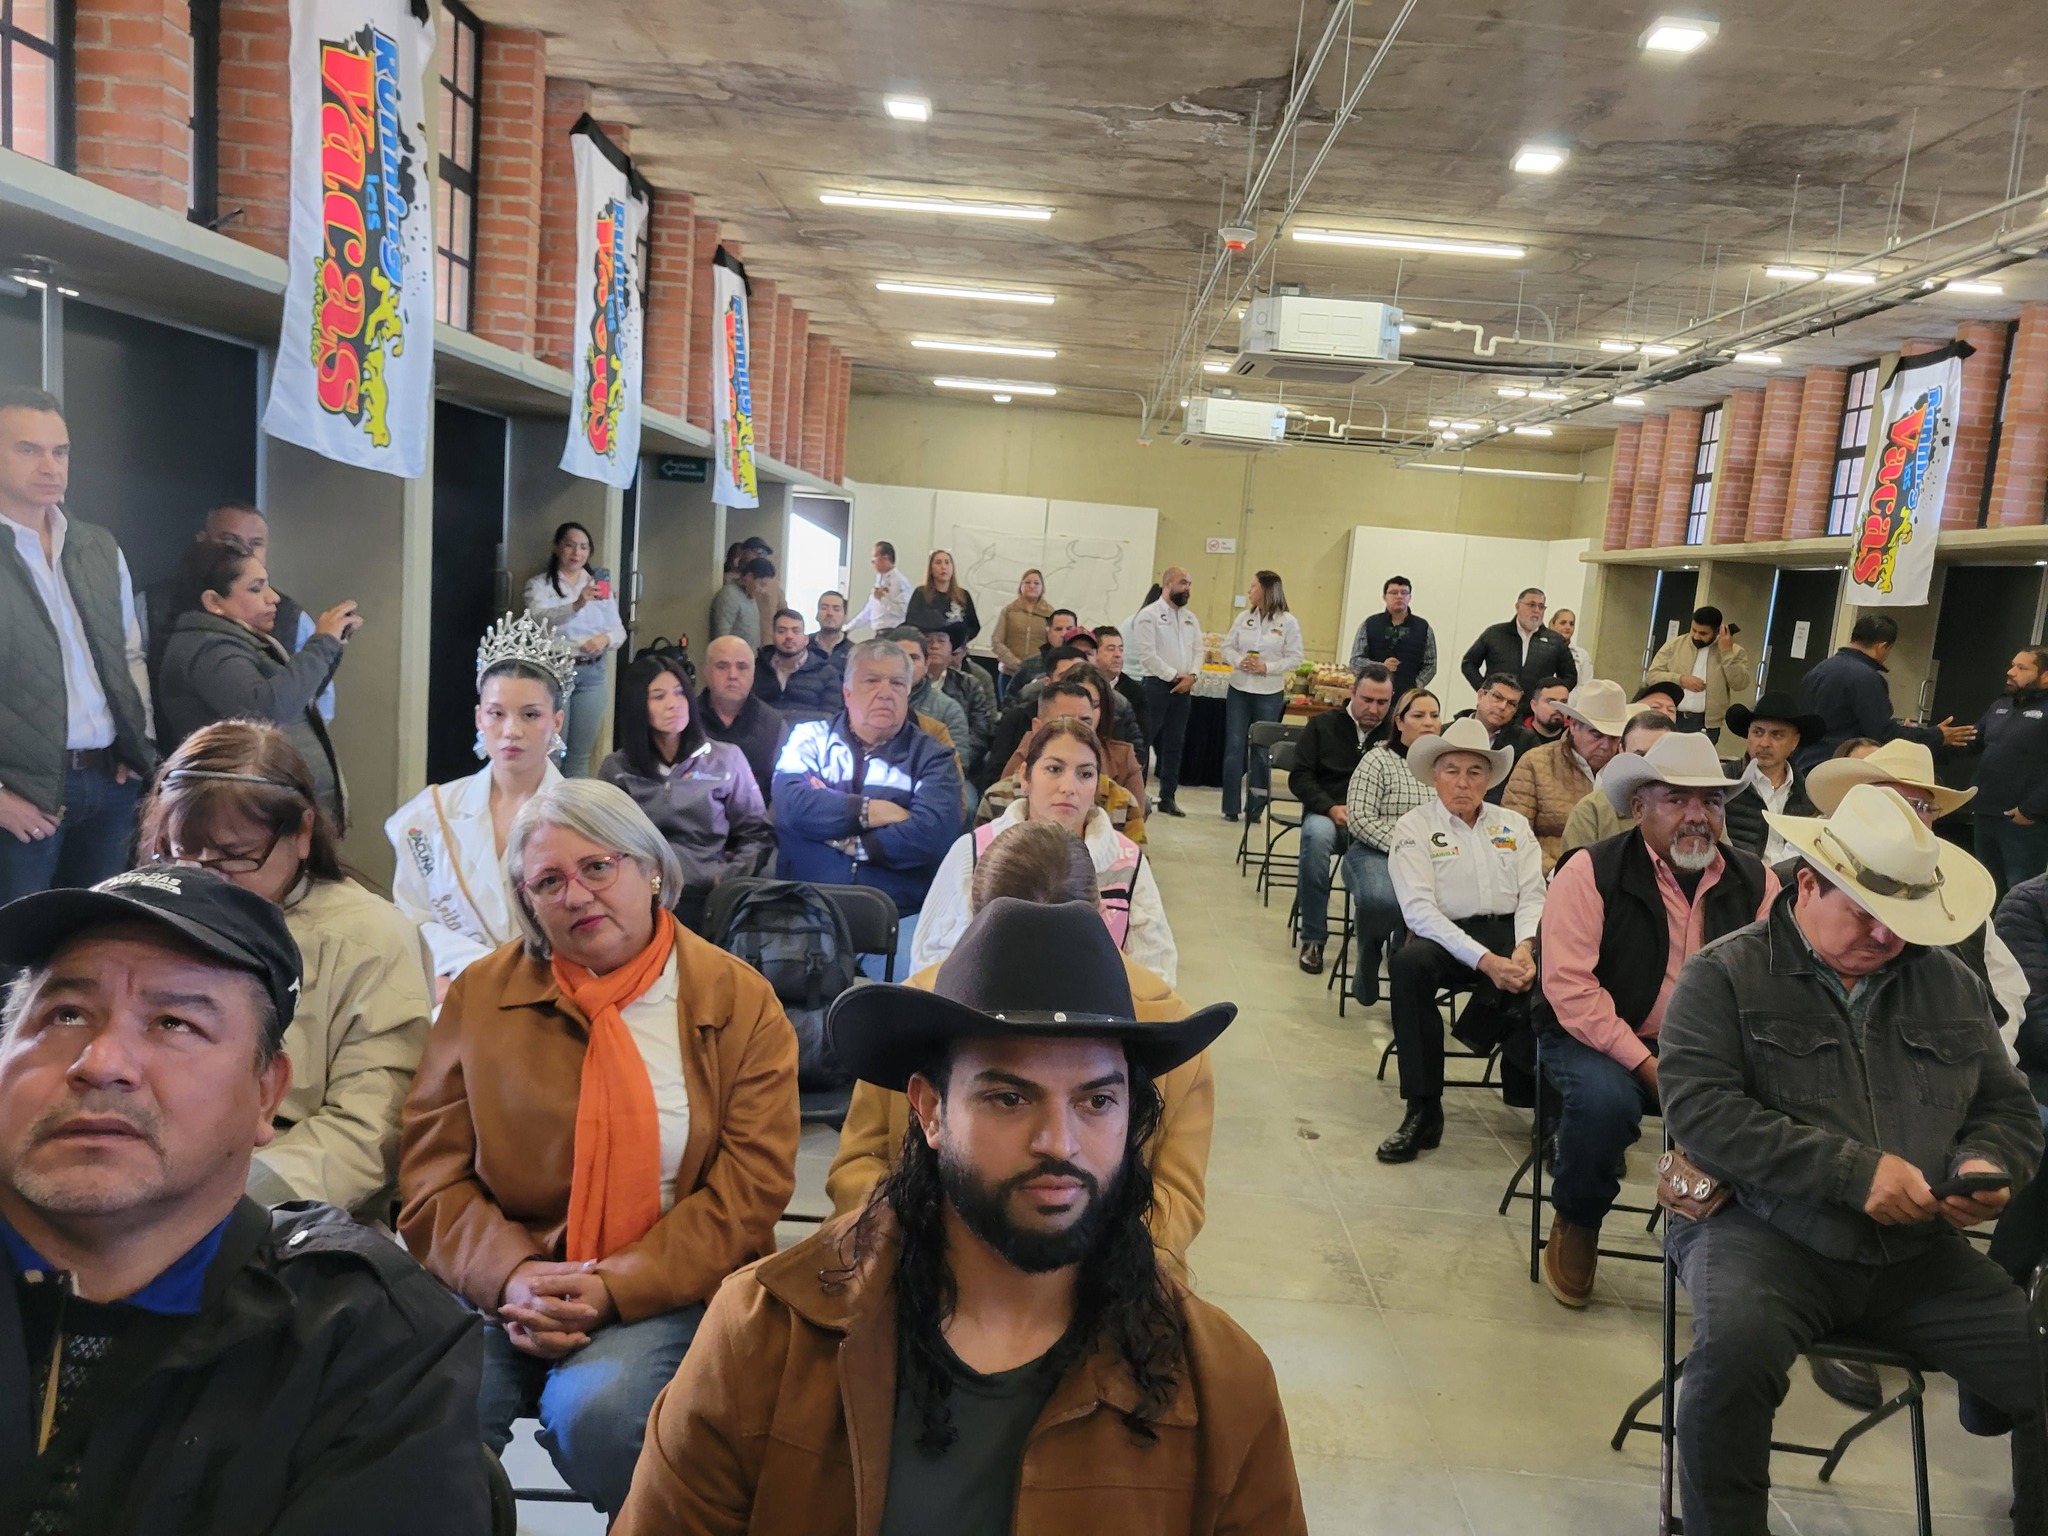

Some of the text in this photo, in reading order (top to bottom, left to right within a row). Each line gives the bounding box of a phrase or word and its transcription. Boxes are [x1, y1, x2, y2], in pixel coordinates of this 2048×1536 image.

[317, 46, 375, 414] Vacas
[366, 175, 381, 230] las
[371, 30, 406, 287] Running
[1853, 403, 1927, 584] Vacas
[1902, 460, 1915, 491] las
